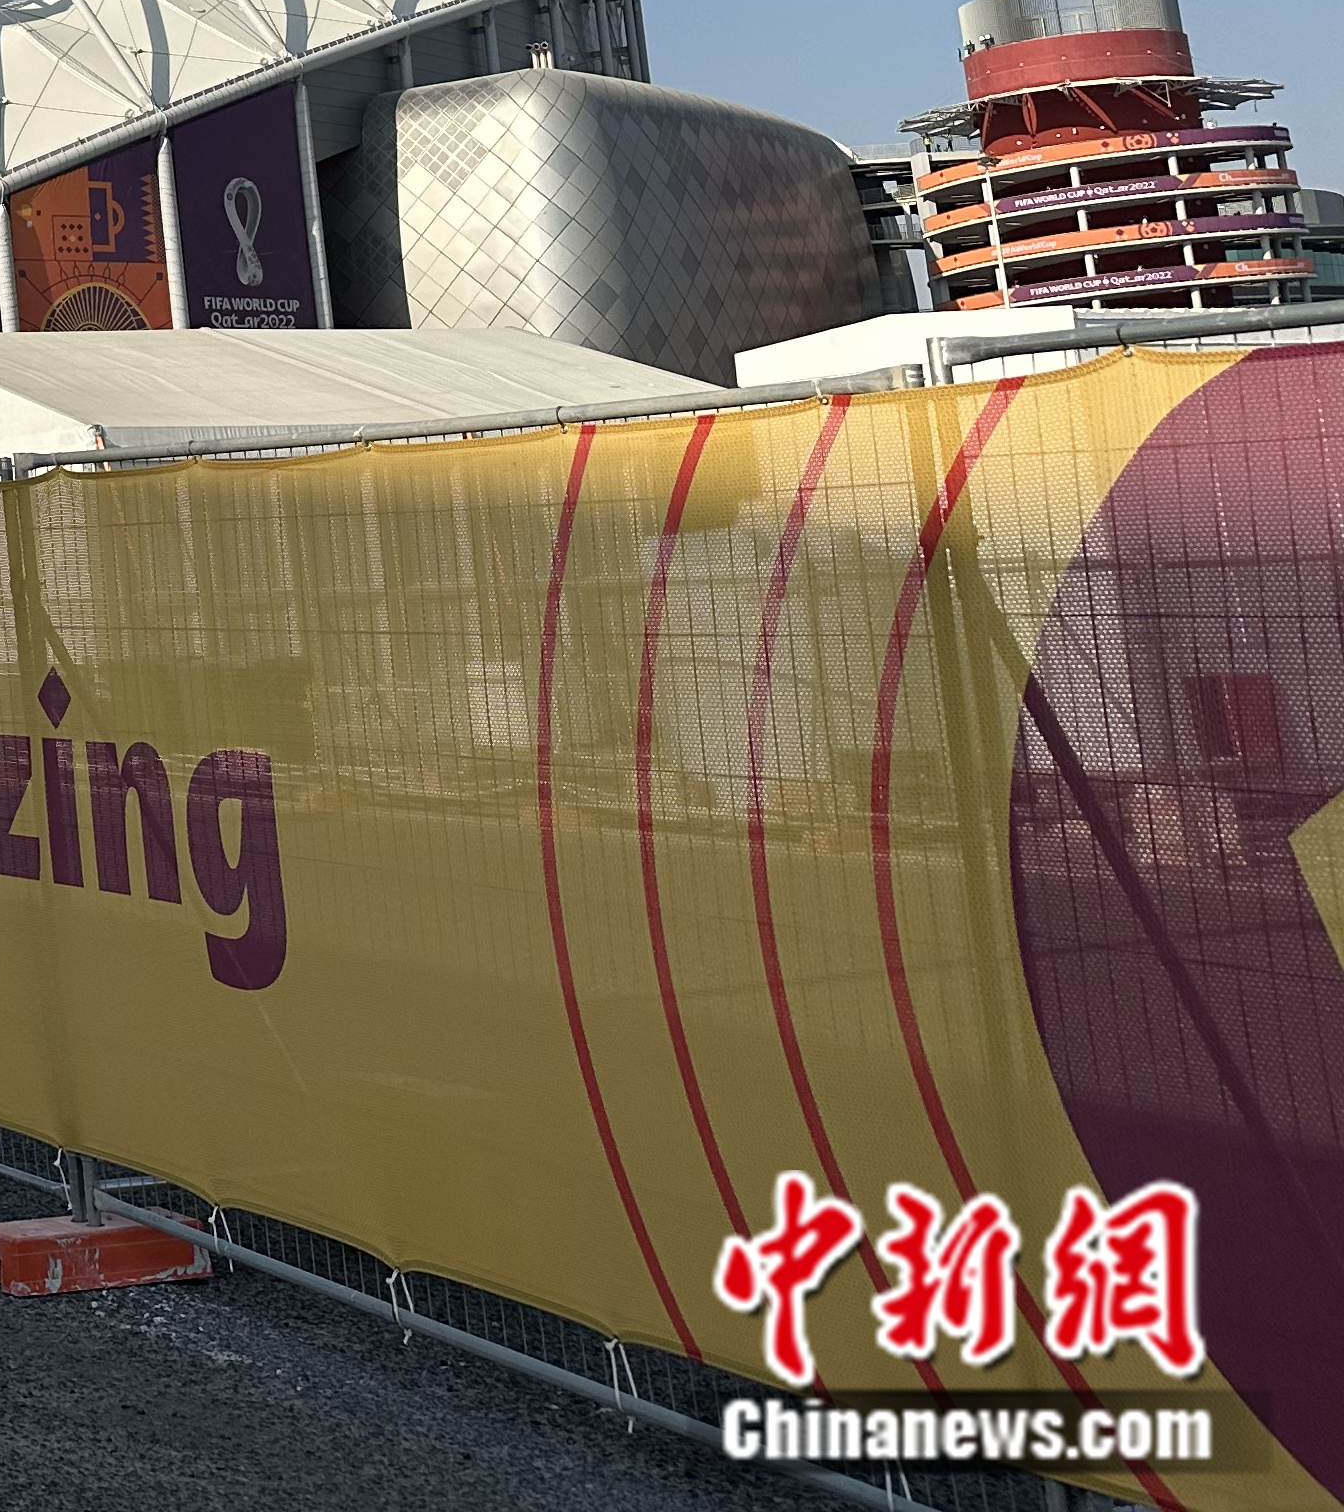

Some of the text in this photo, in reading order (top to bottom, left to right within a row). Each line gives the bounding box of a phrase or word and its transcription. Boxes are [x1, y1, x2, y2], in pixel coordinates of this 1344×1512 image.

[1014, 198, 1033, 208] FIFA
[1033, 192, 1066, 204] WORLD
[1067, 189, 1085, 199] CUP
[1029, 287, 1049, 296] FIFA
[1049, 282, 1082, 293] WORLD
[1083, 279, 1102, 289] CUP
[203, 296, 300, 312] FIFA WORLD CUP
